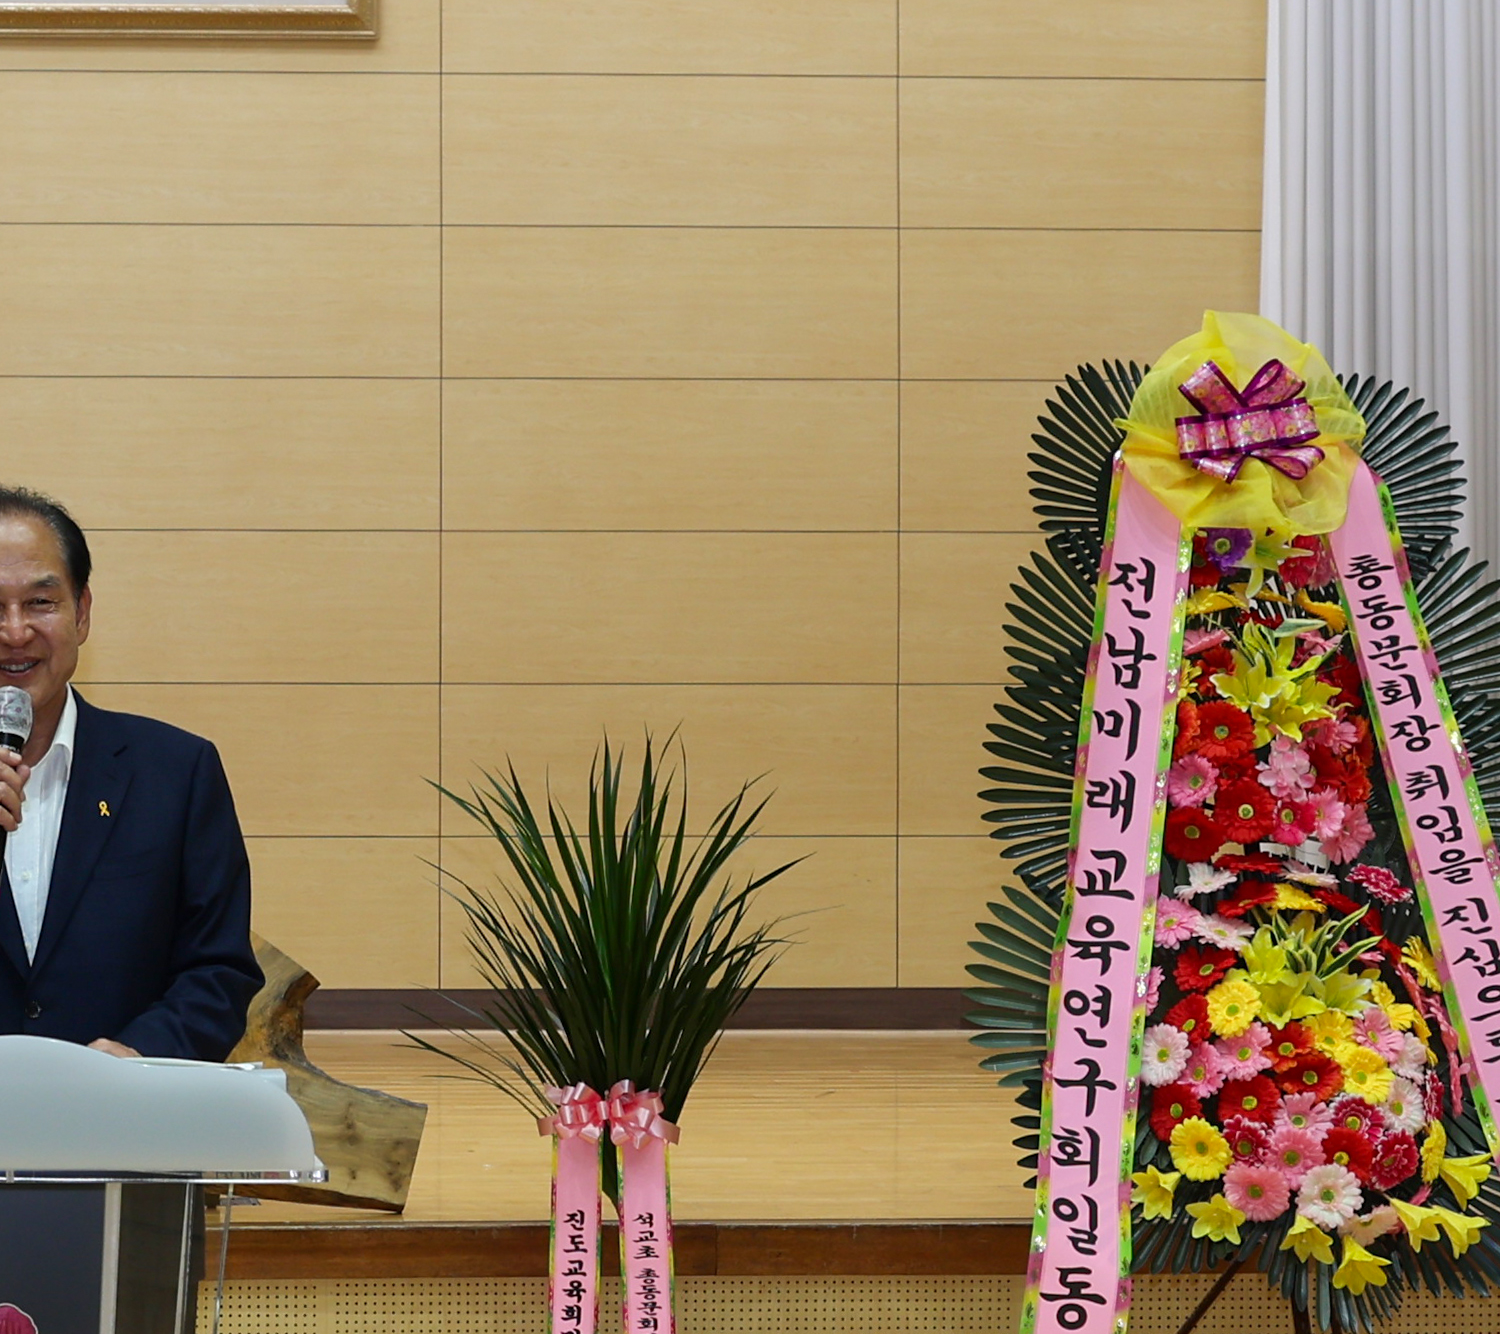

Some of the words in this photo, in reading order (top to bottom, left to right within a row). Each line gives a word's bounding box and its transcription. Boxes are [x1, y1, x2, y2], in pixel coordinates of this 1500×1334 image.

[1344, 554, 1440, 752] 총동문회장
[1404, 764, 1485, 885] 취임을
[632, 1212, 659, 1260] 석교초
